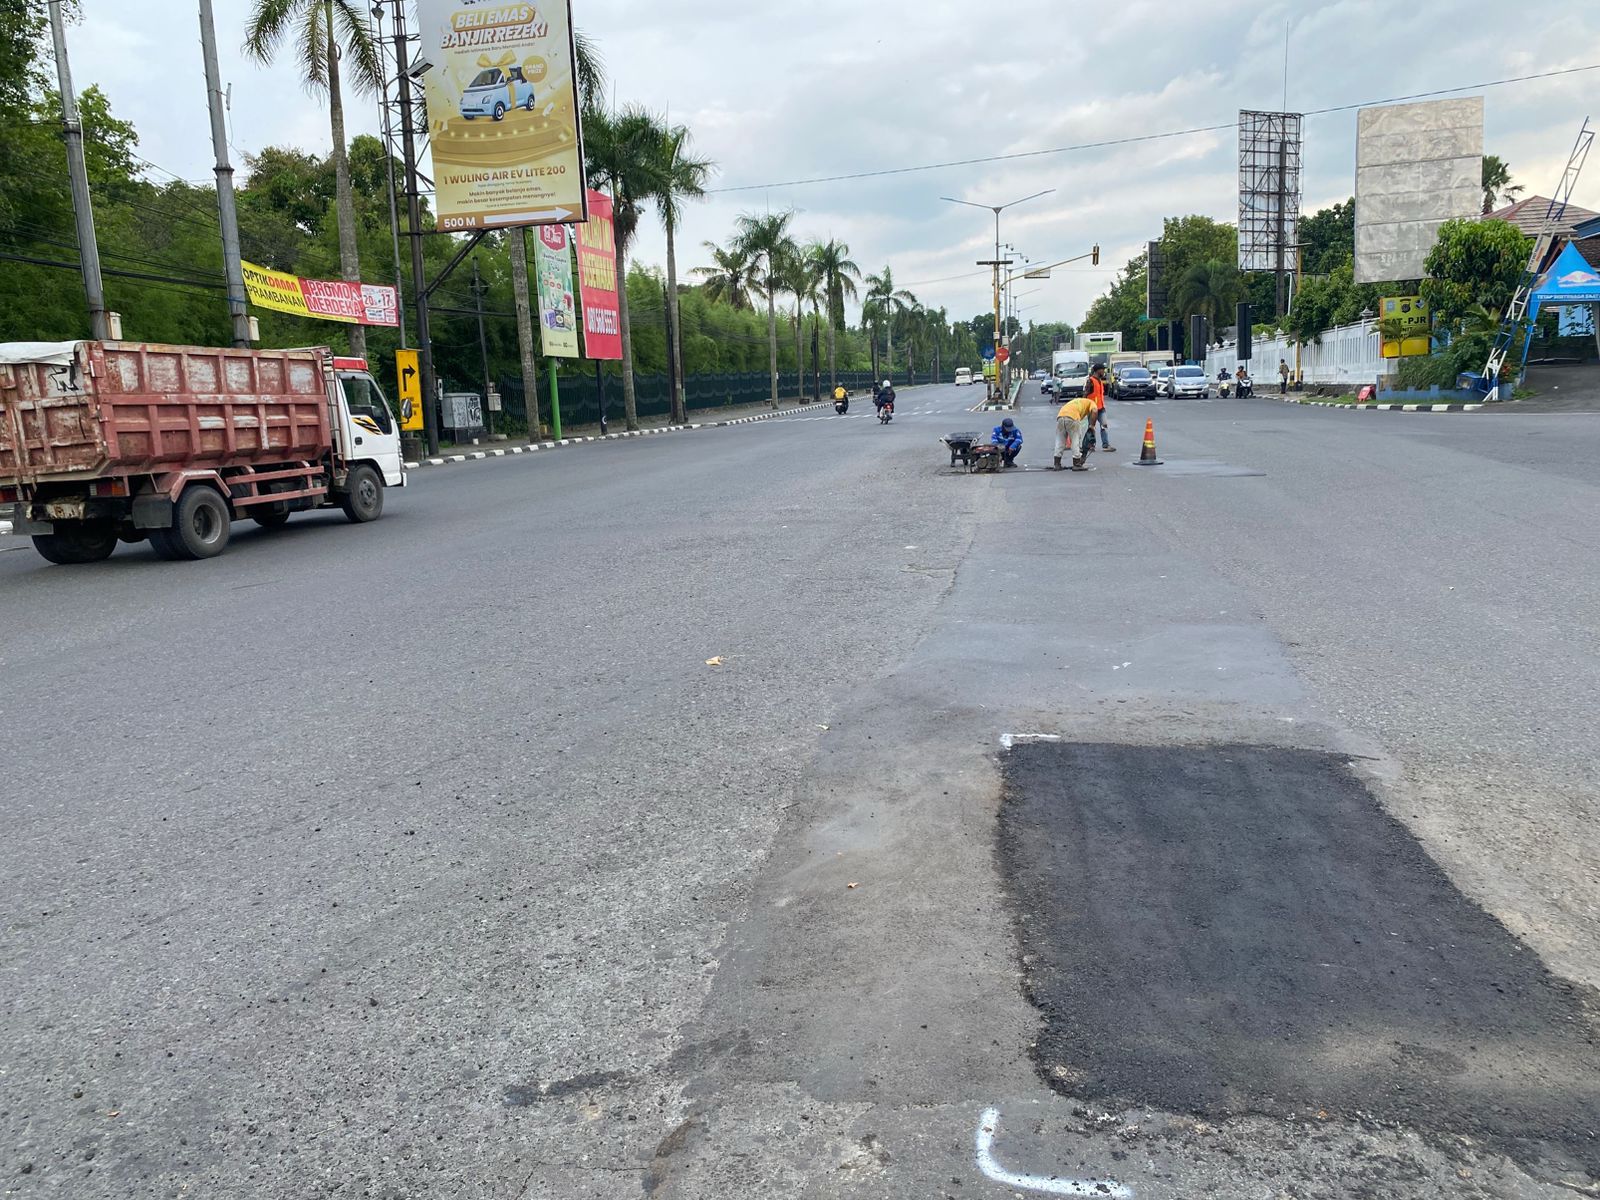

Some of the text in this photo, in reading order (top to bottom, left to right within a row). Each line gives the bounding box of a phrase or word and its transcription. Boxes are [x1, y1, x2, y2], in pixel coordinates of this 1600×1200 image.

[456, 6, 530, 28] BELI EMAS
[441, 22, 548, 49] BANJIR REZEKI
[449, 173, 490, 185] WULING
[491, 170, 509, 181] AIR
[511, 169, 524, 179] EV
[525, 167, 545, 177] LITE
[547, 165, 566, 175] 200
[486, 188, 505, 197] banyak
[506, 187, 526, 195] belanja
[489, 195, 522, 203] kesempatan
[522, 191, 556, 200] menangnya!
[444, 217, 476, 228] 500 M
[246, 283, 306, 308] PRAMBANAN
[306, 280, 352, 300] PROMO
[305, 294, 363, 317] MERDEKA
